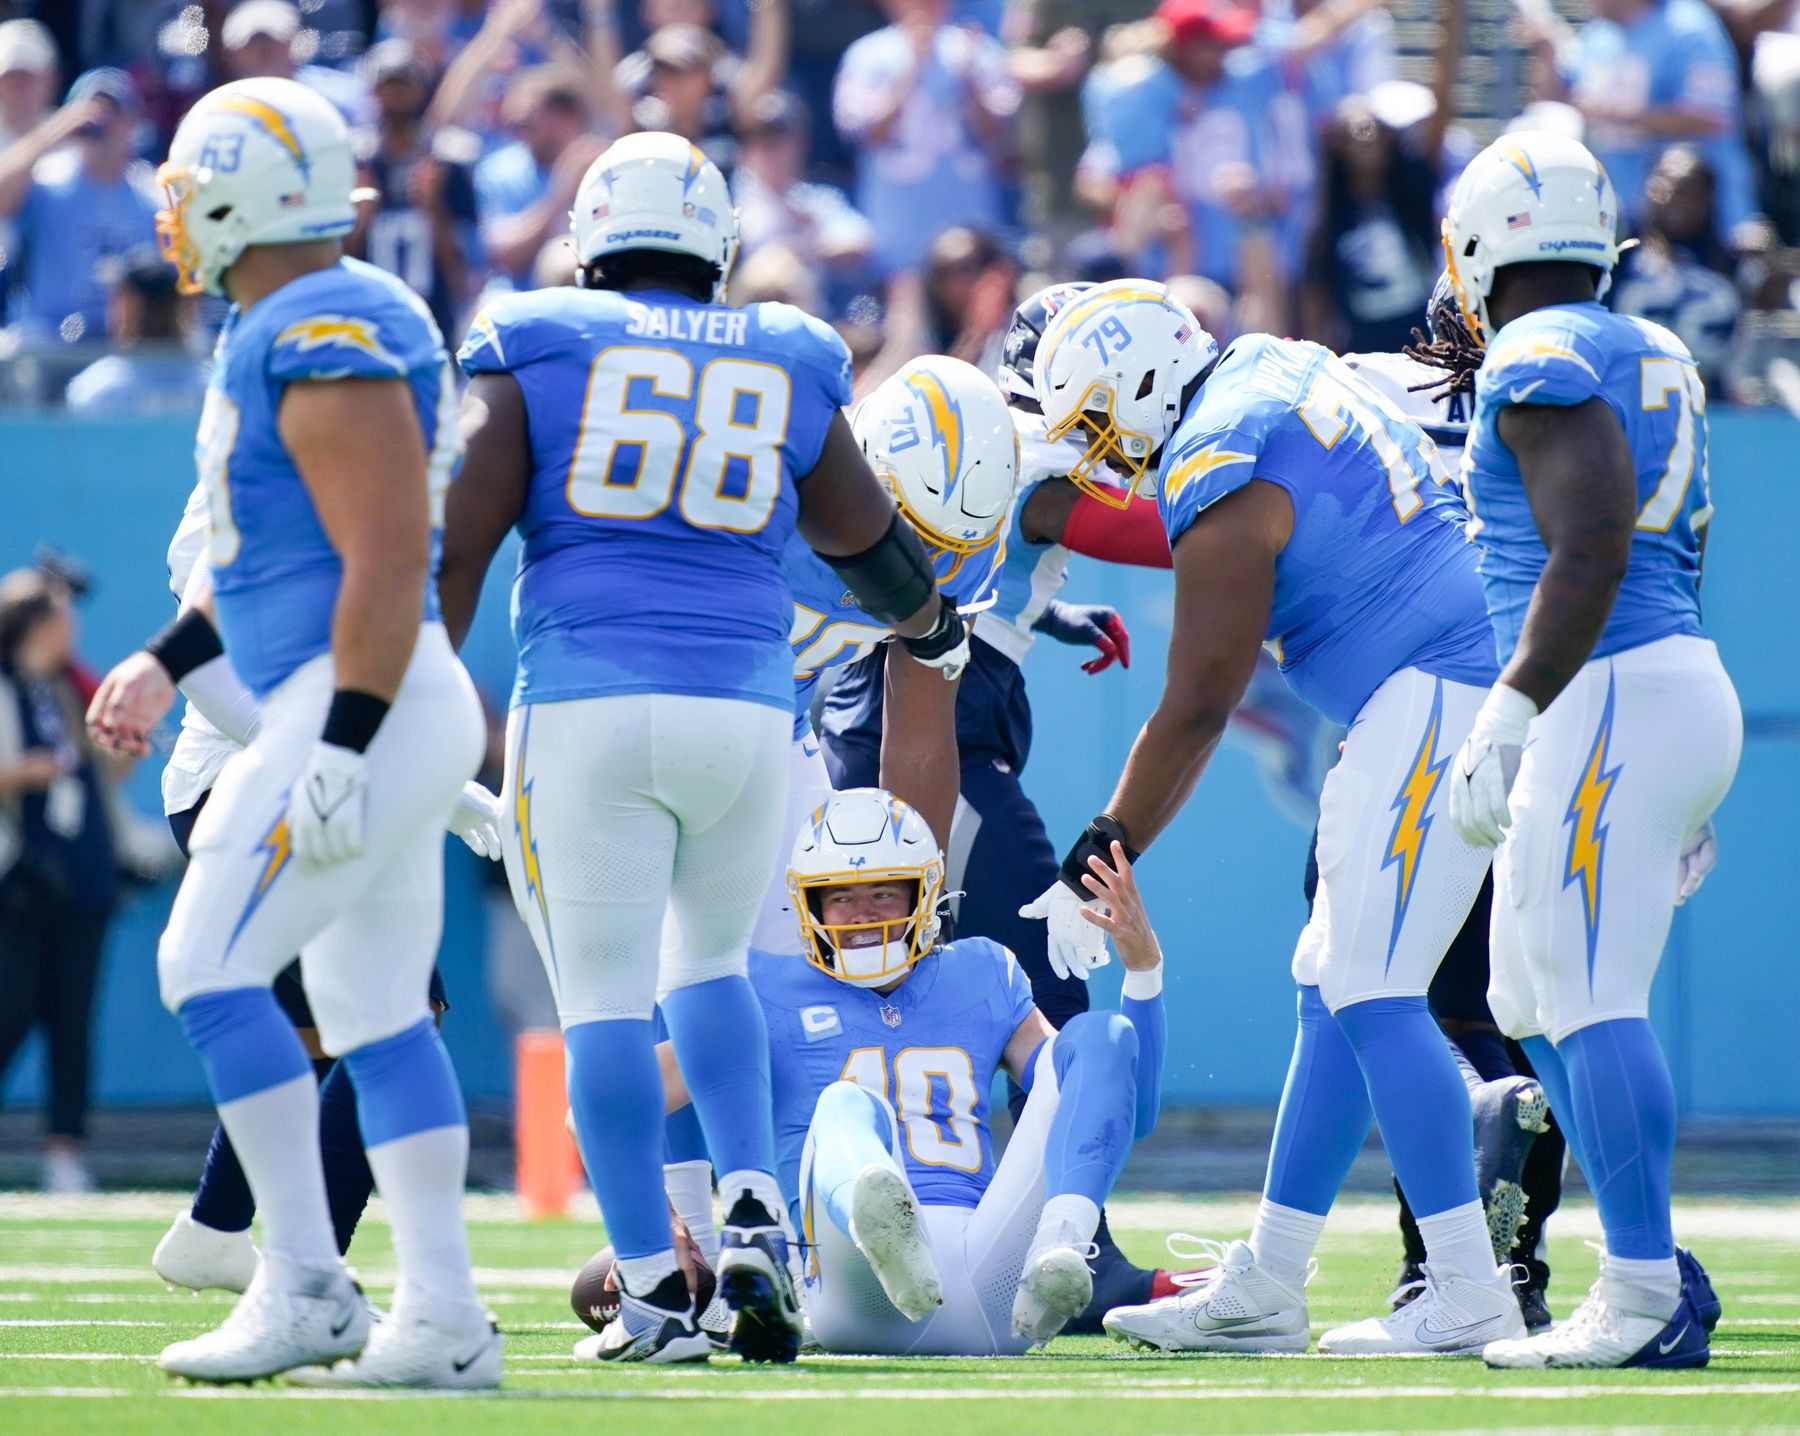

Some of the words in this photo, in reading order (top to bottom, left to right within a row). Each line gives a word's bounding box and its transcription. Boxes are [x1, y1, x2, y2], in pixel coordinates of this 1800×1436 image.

[200, 133, 246, 174] 63
[626, 301, 748, 346] SALYER
[1081, 314, 1133, 368] 79
[565, 345, 792, 534] 68
[882, 404, 921, 454] 70
[801, 1005, 838, 1034] C
[838, 1045, 983, 1174] 10
